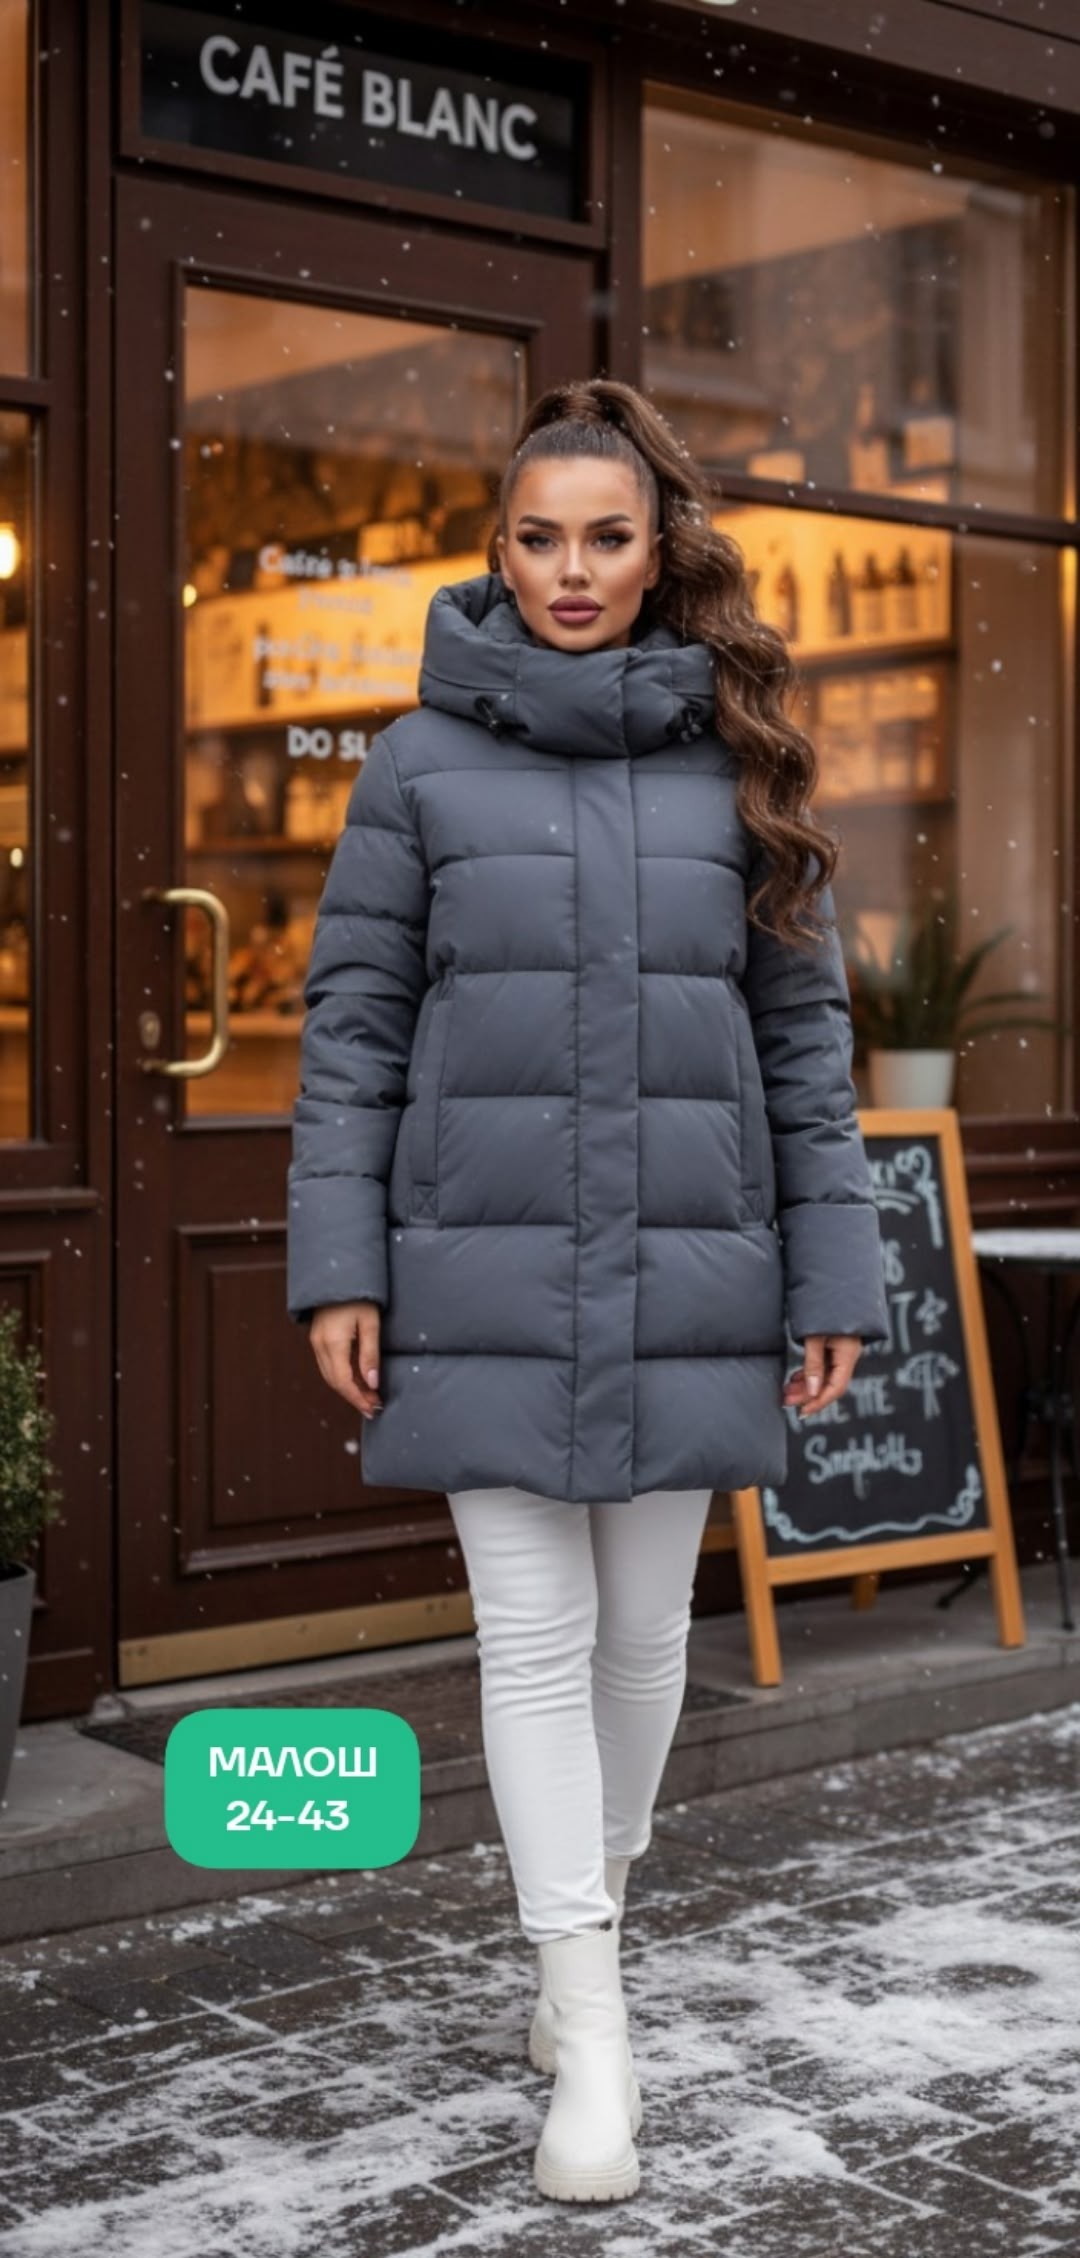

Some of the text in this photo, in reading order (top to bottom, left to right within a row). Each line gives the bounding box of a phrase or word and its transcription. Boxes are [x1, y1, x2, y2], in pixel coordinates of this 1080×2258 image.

[200, 35, 537, 160] CAFÉ BLANC
[287, 726, 332, 759] DO
